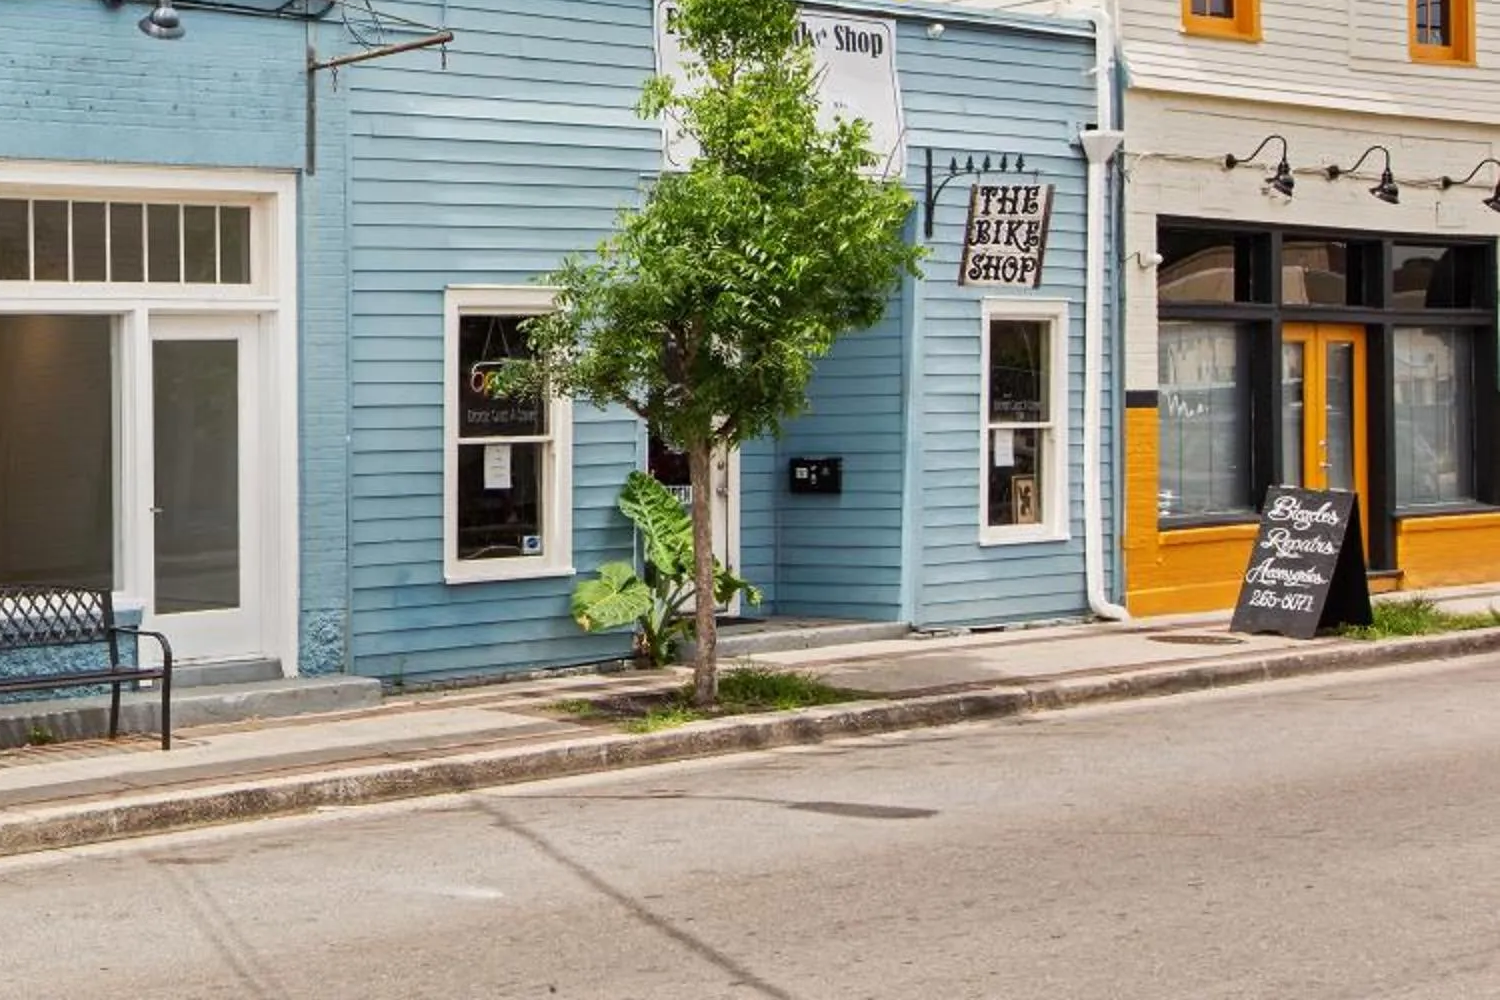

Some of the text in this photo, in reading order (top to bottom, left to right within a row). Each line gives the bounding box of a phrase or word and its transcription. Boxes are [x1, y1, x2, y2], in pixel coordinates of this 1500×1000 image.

[833, 23, 884, 59] Shop
[980, 185, 1041, 215] THE
[968, 219, 1041, 253] BIKE
[967, 253, 1037, 283] SHOP
[1268, 496, 1340, 531] Bicycles
